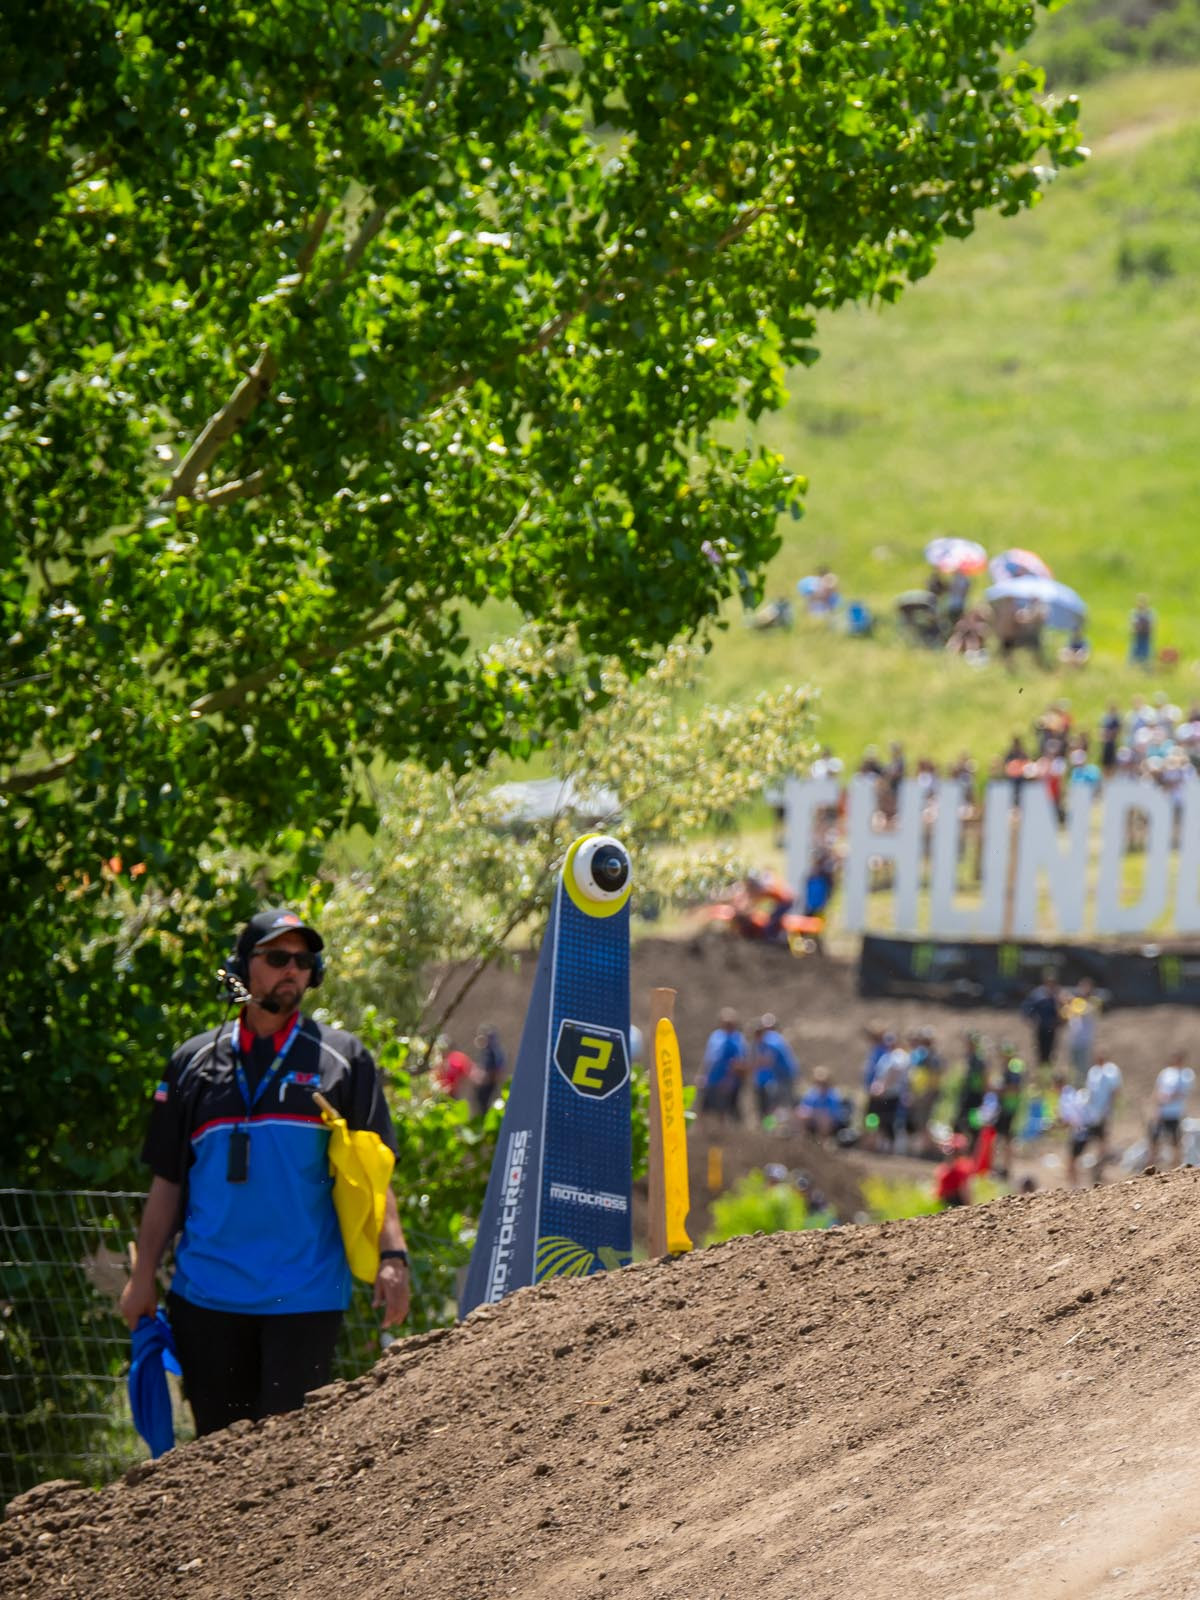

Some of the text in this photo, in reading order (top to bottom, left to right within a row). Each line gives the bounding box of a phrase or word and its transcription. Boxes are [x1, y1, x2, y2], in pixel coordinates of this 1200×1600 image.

[572, 1036, 613, 1089] 2
[489, 1129, 528, 1304] MOTOCROSS
[550, 1186, 627, 1211] MOTOCROSS
